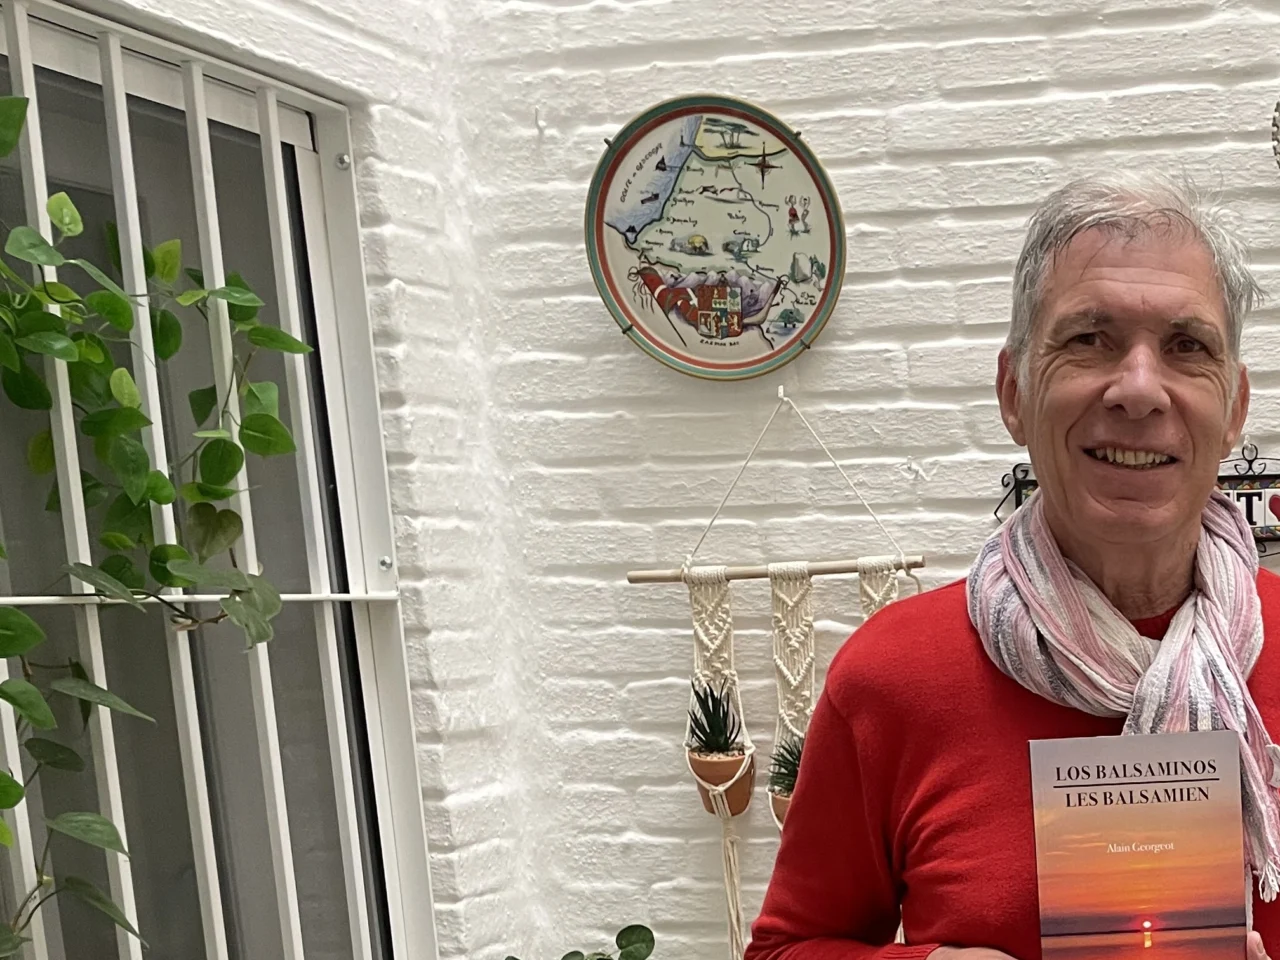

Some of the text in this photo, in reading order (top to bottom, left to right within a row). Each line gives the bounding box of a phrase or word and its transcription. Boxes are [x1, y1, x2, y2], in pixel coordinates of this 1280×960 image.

[1223, 490, 1263, 526] T
[1055, 758, 1218, 782] LOS BALSAMINOS
[1065, 786, 1211, 808] LES BALSAMIEN
[1106, 843, 1131, 853] Alain
